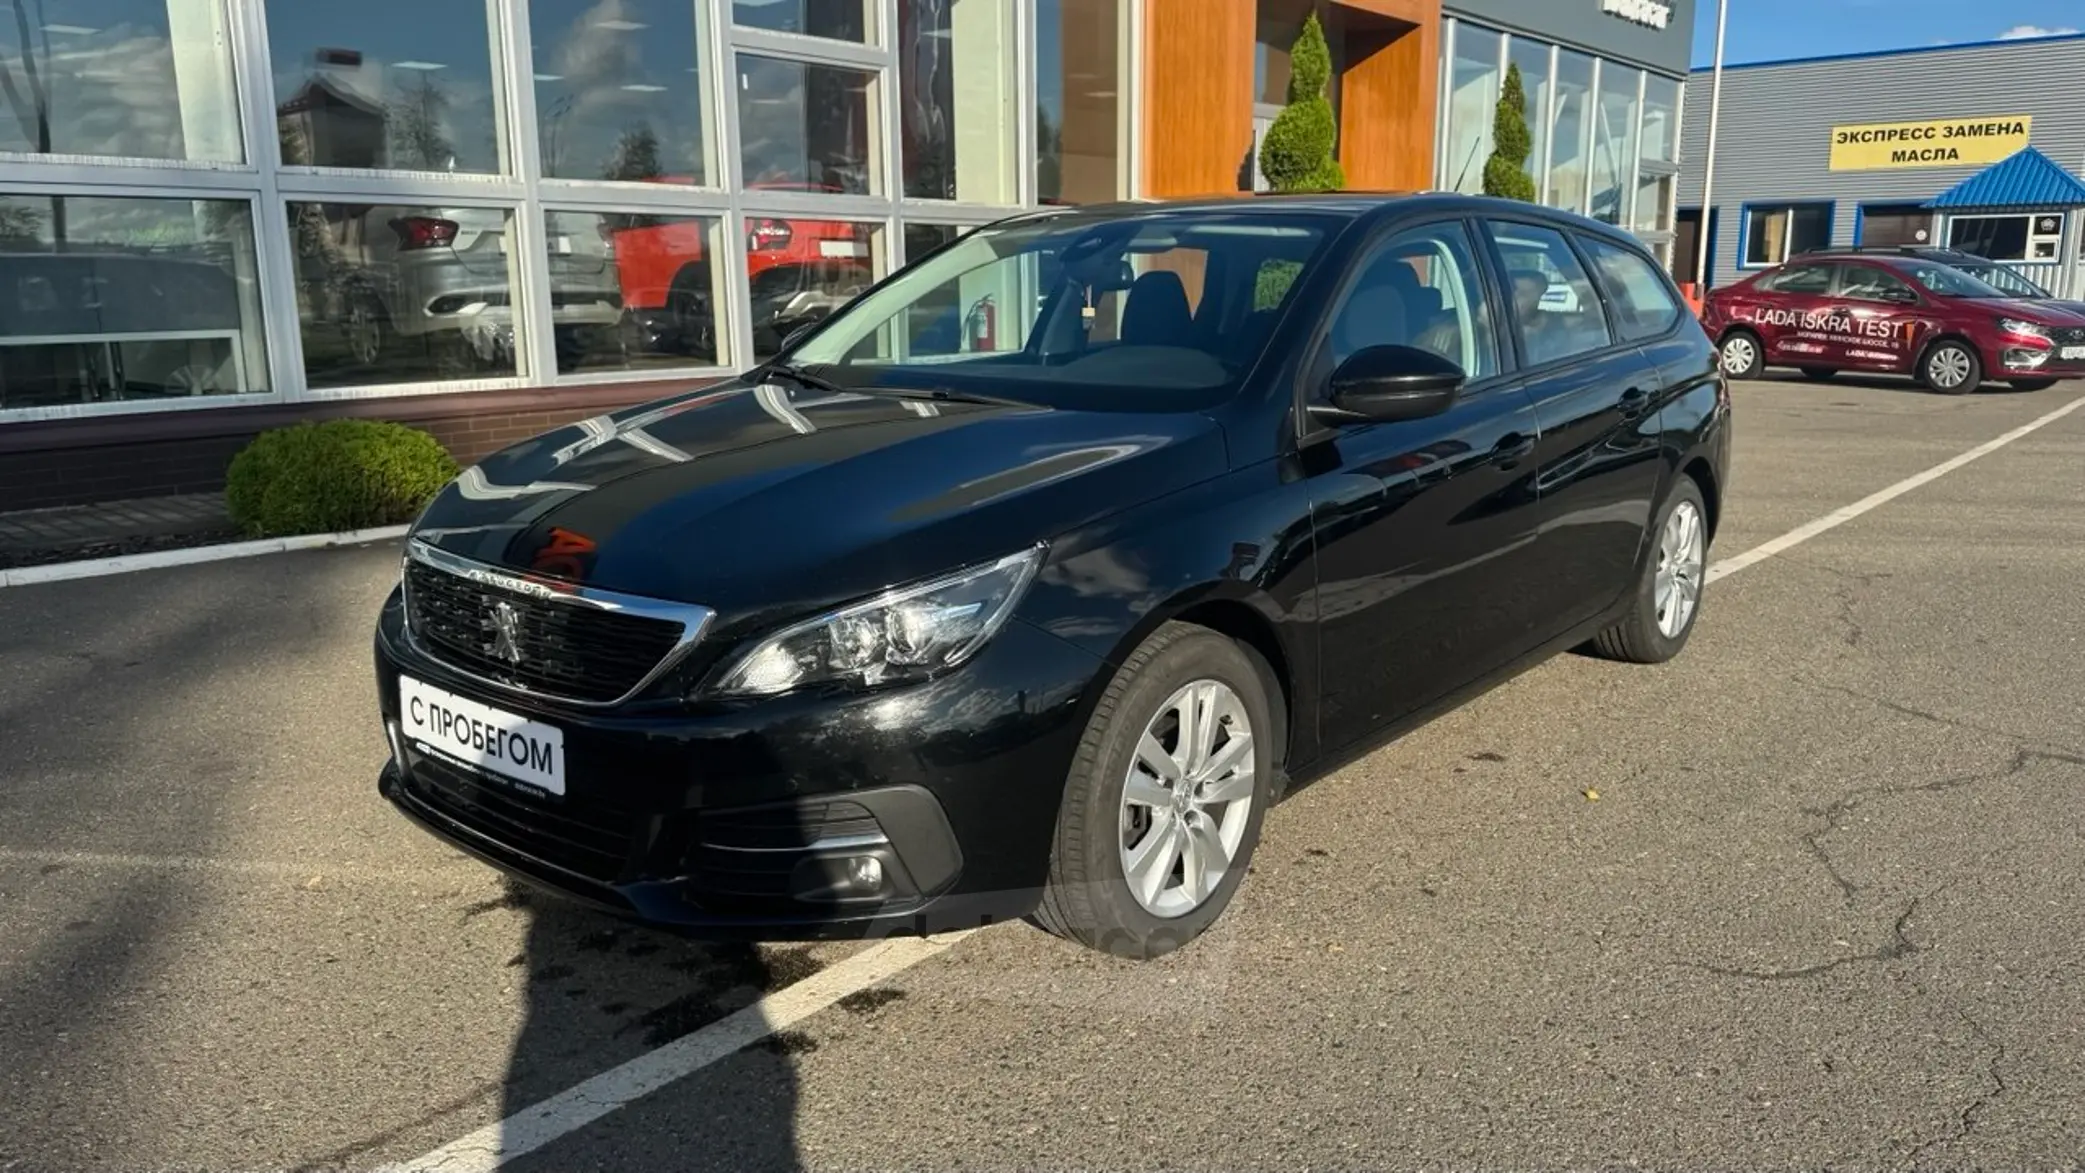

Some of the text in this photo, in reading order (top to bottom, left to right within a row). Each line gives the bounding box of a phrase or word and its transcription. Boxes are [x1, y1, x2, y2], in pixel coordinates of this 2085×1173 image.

[1837, 122, 2025, 144] ЭКСПРЕСС ЗАМЕНА
[1891, 148, 1959, 162] МАСЛА
[1755, 308, 1903, 338] LADA ISKRA TEST
[410, 696, 424, 726] С
[429, 703, 553, 775] ПРОБЕГОМ
